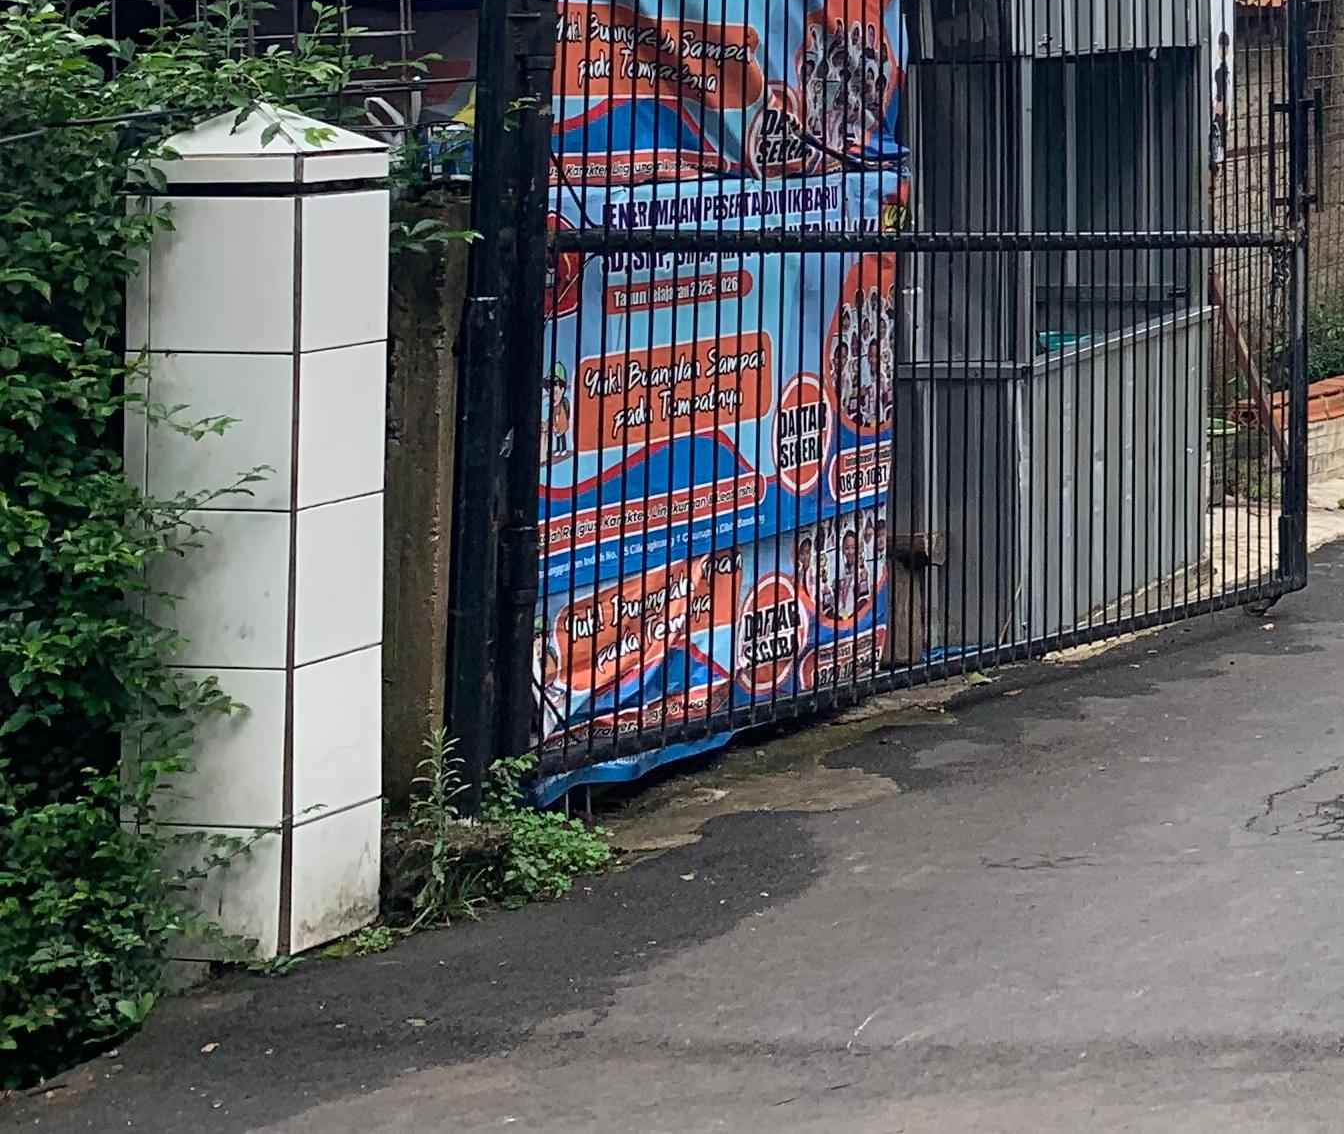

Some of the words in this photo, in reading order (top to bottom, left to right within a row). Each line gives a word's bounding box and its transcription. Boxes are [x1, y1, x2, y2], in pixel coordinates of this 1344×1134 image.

[762, 188, 802, 216] DIIK
[614, 290, 647, 306] Taun
[690, 277, 738, 298] 225-026
[780, 403, 828, 437] DATA
